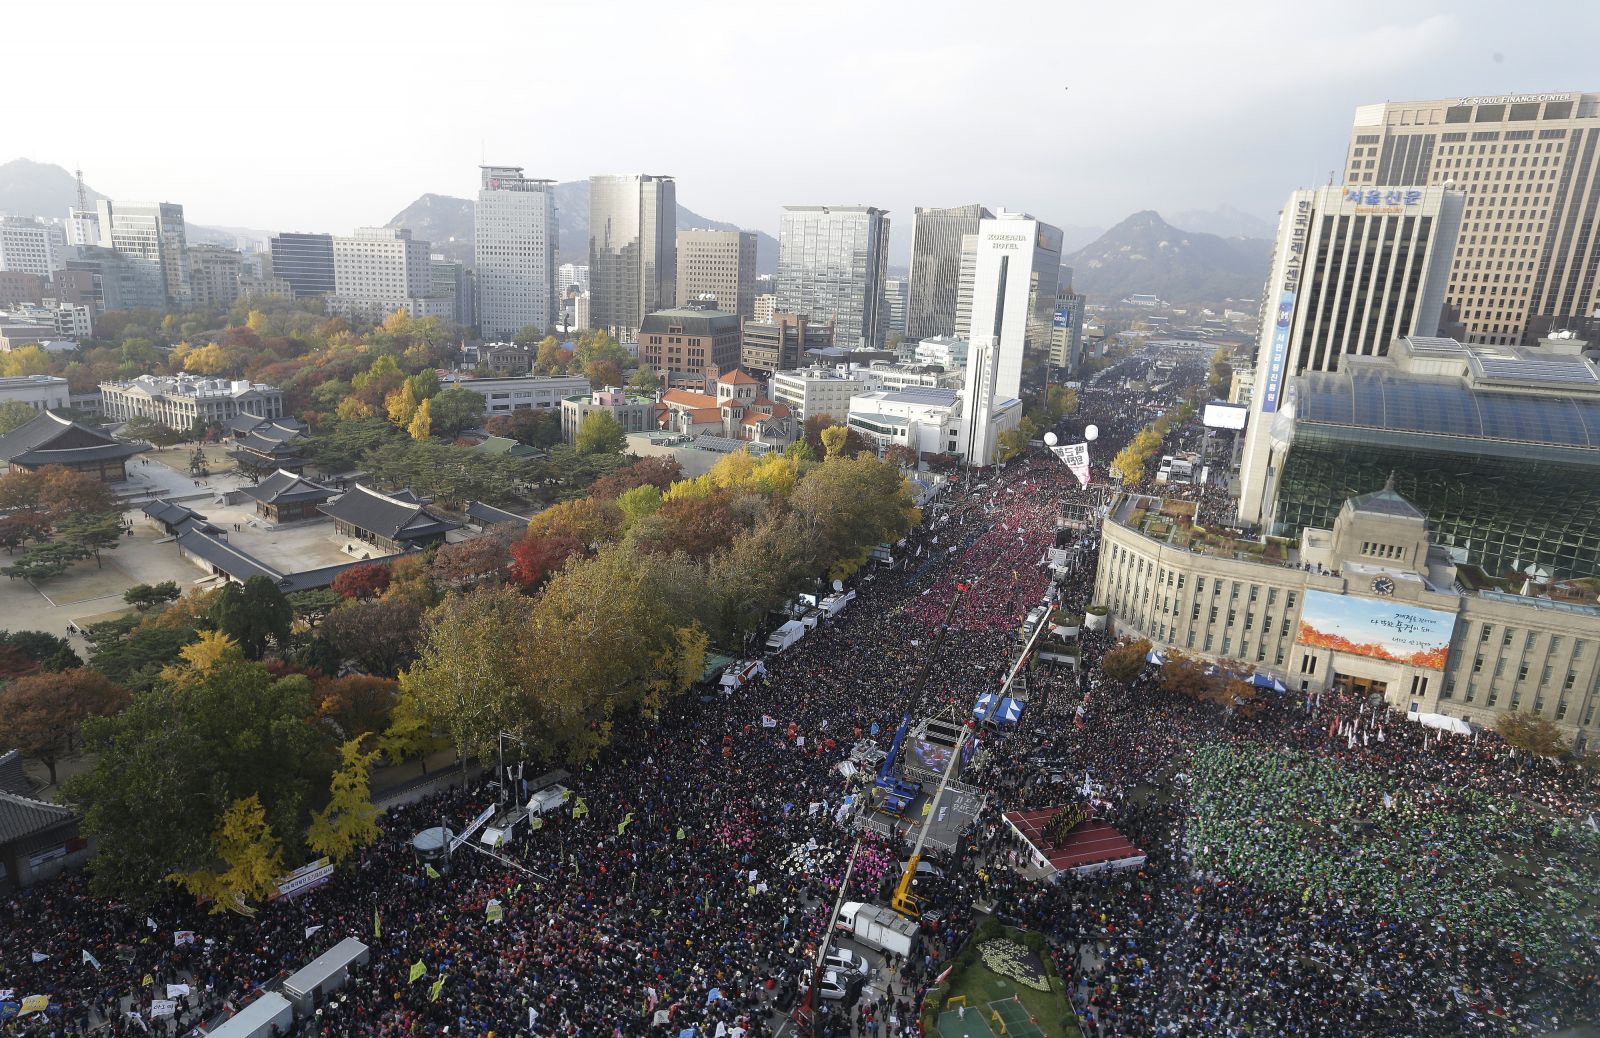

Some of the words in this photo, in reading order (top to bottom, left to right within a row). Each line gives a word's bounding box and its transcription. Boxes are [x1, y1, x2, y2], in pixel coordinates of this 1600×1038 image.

[1472, 96, 1498, 104] SEOUL
[1501, 94, 1537, 103] FINANCE
[1538, 92, 1571, 101] CENTER
[1346, 190, 1421, 205] 서울신문
[1285, 200, 1310, 294] 한국프레스센터
